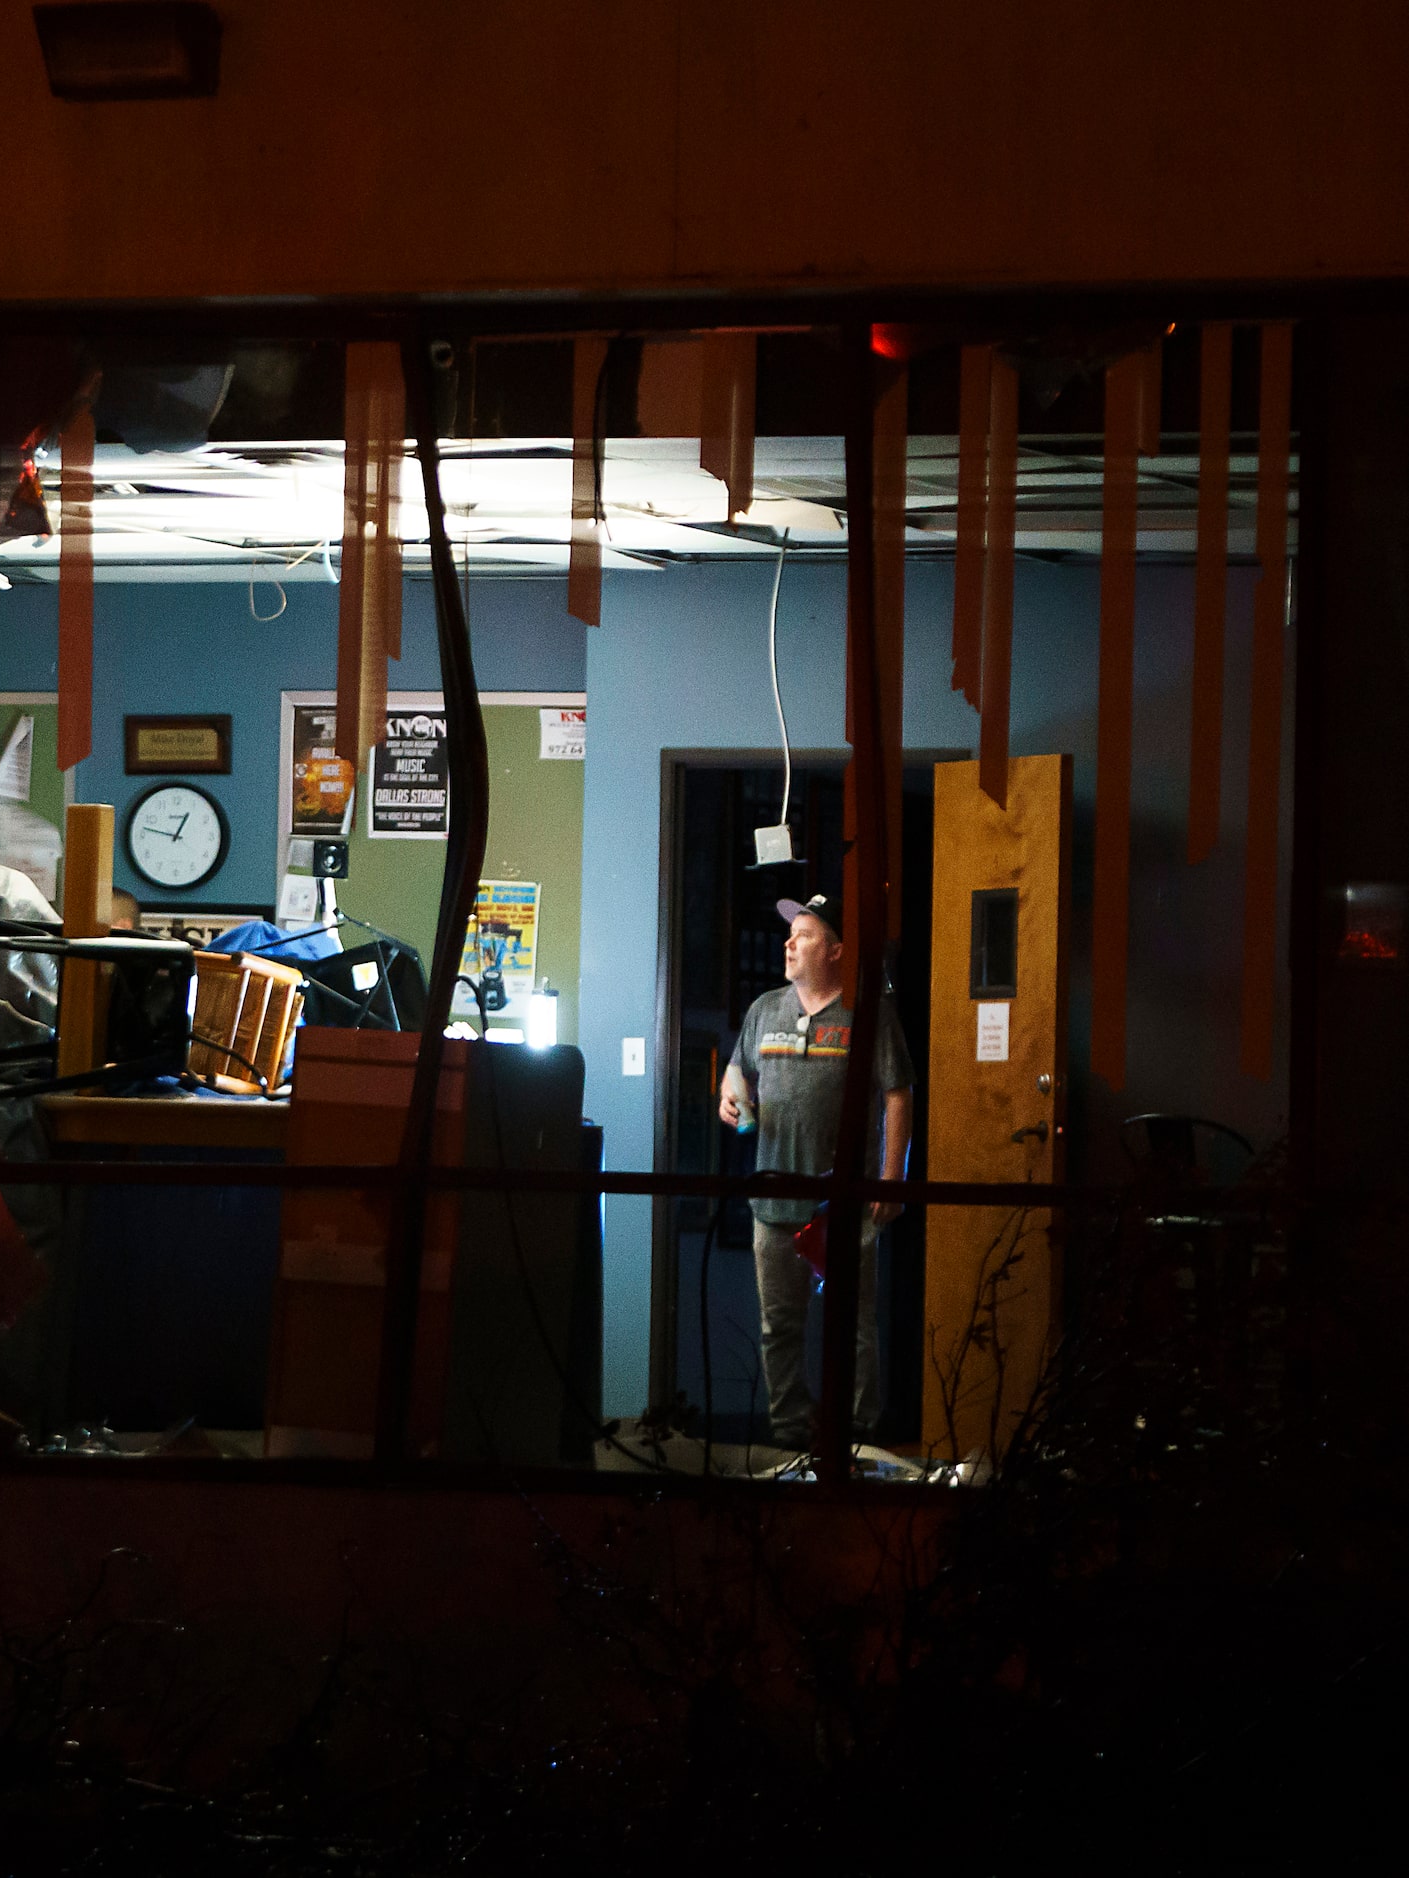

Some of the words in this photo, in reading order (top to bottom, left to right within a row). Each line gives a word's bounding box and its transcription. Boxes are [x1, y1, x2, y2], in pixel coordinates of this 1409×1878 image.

[395, 758, 426, 773] MUSIC
[375, 789, 410, 803] DALLAS
[410, 789, 446, 804] STRONG
